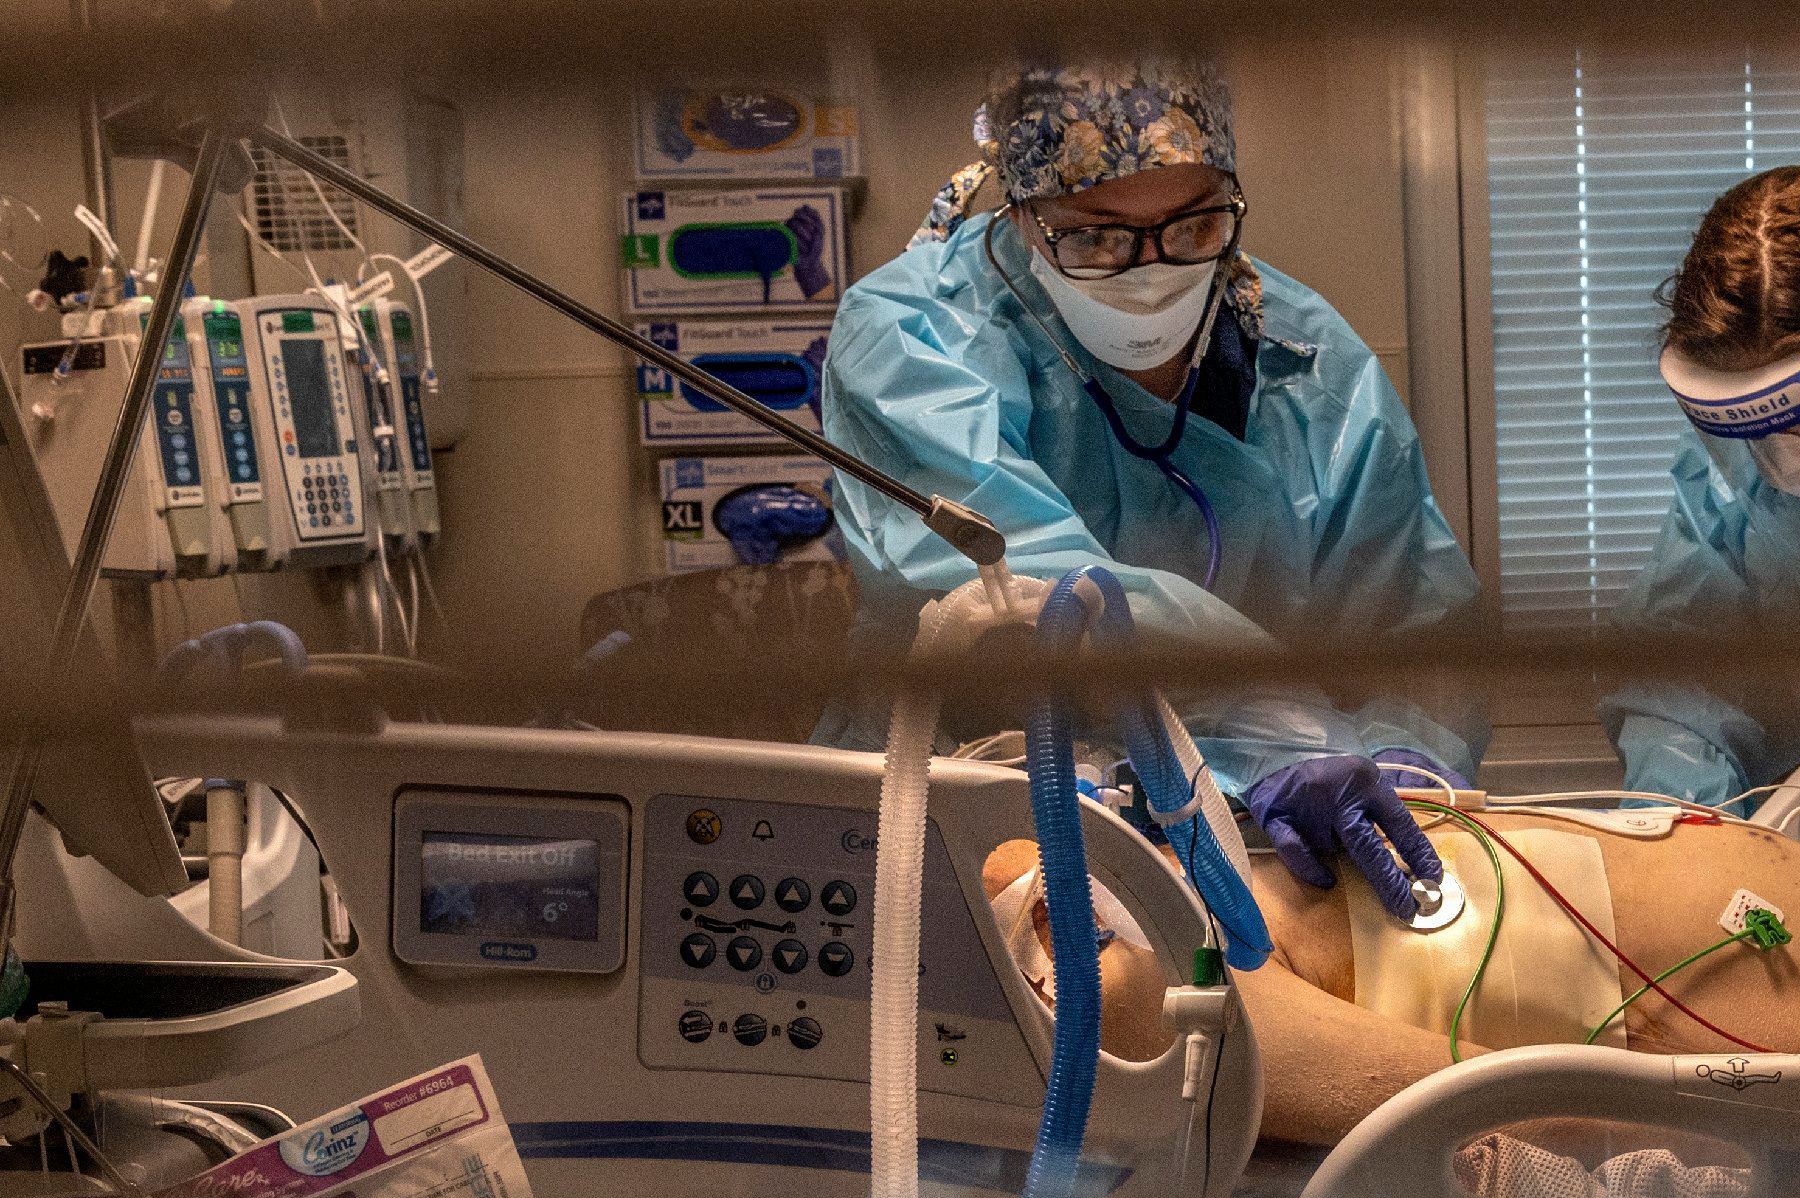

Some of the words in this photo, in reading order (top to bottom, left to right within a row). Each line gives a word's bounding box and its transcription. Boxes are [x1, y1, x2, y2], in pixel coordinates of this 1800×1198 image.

[637, 238, 650, 258] L
[644, 370, 666, 390] M
[1726, 393, 1791, 421] Shield
[1769, 412, 1797, 426] Mask
[667, 505, 699, 529] XL
[449, 843, 490, 861] Bed
[496, 845, 538, 864] Exit
[541, 846, 576, 867] Off
